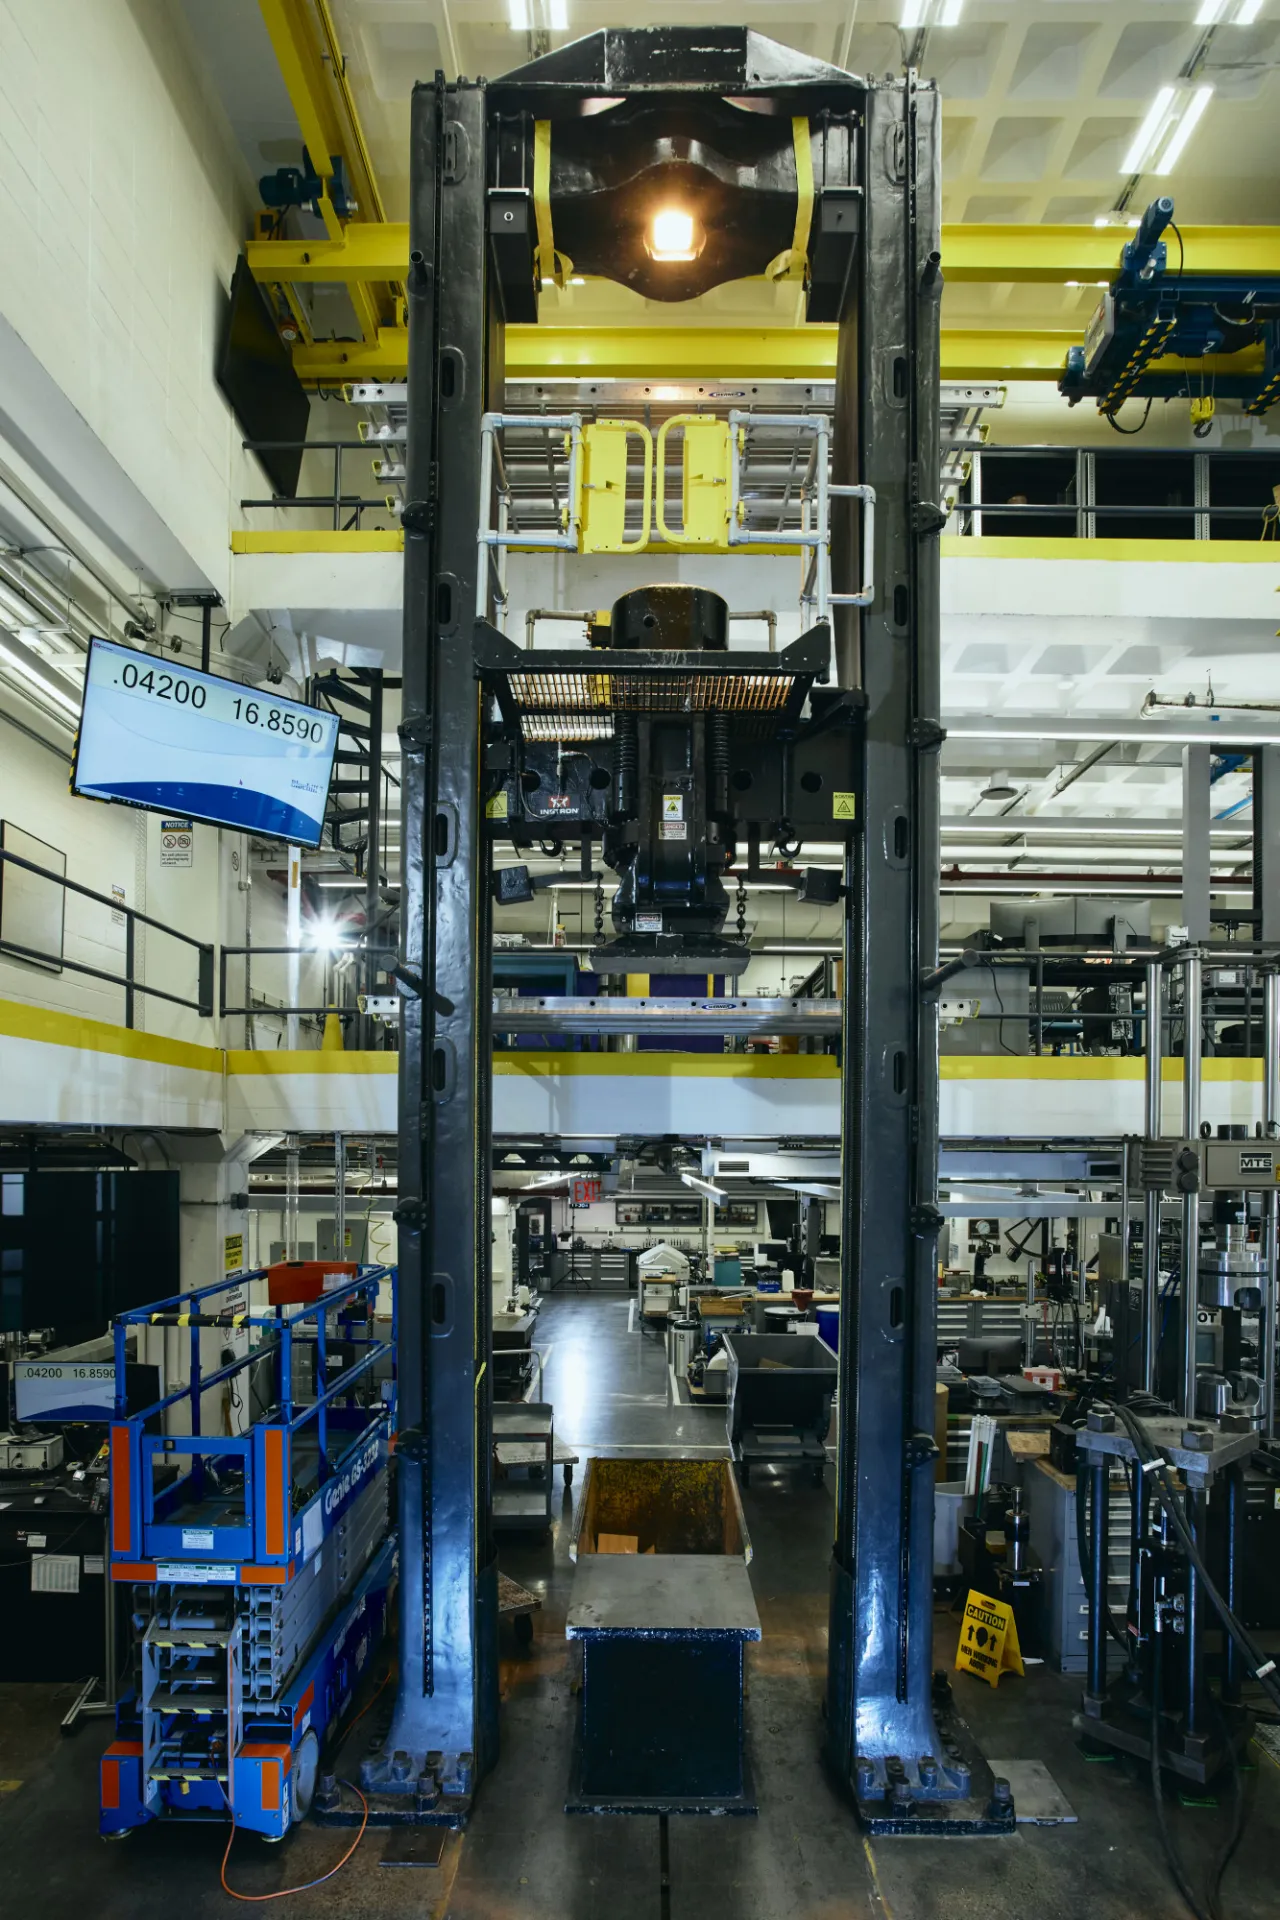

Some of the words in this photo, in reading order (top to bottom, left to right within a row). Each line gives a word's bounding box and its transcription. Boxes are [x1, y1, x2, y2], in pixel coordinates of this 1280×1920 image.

[113, 664, 206, 709] .04200
[232, 698, 323, 744] 16.8590
[1241, 1159, 1272, 1167] MTS
[574, 1181, 602, 1202] EXIT
[23, 1367, 63, 1379] .04200
[73, 1368, 116, 1379] 16.8590
[325, 1474, 351, 1515] Genie
[967, 1605, 1005, 1630] CAUTION
[961, 1644, 973, 1656] MEN
[973, 1649, 998, 1668] WORKING
[968, 1657, 986, 1673] ABOVE
